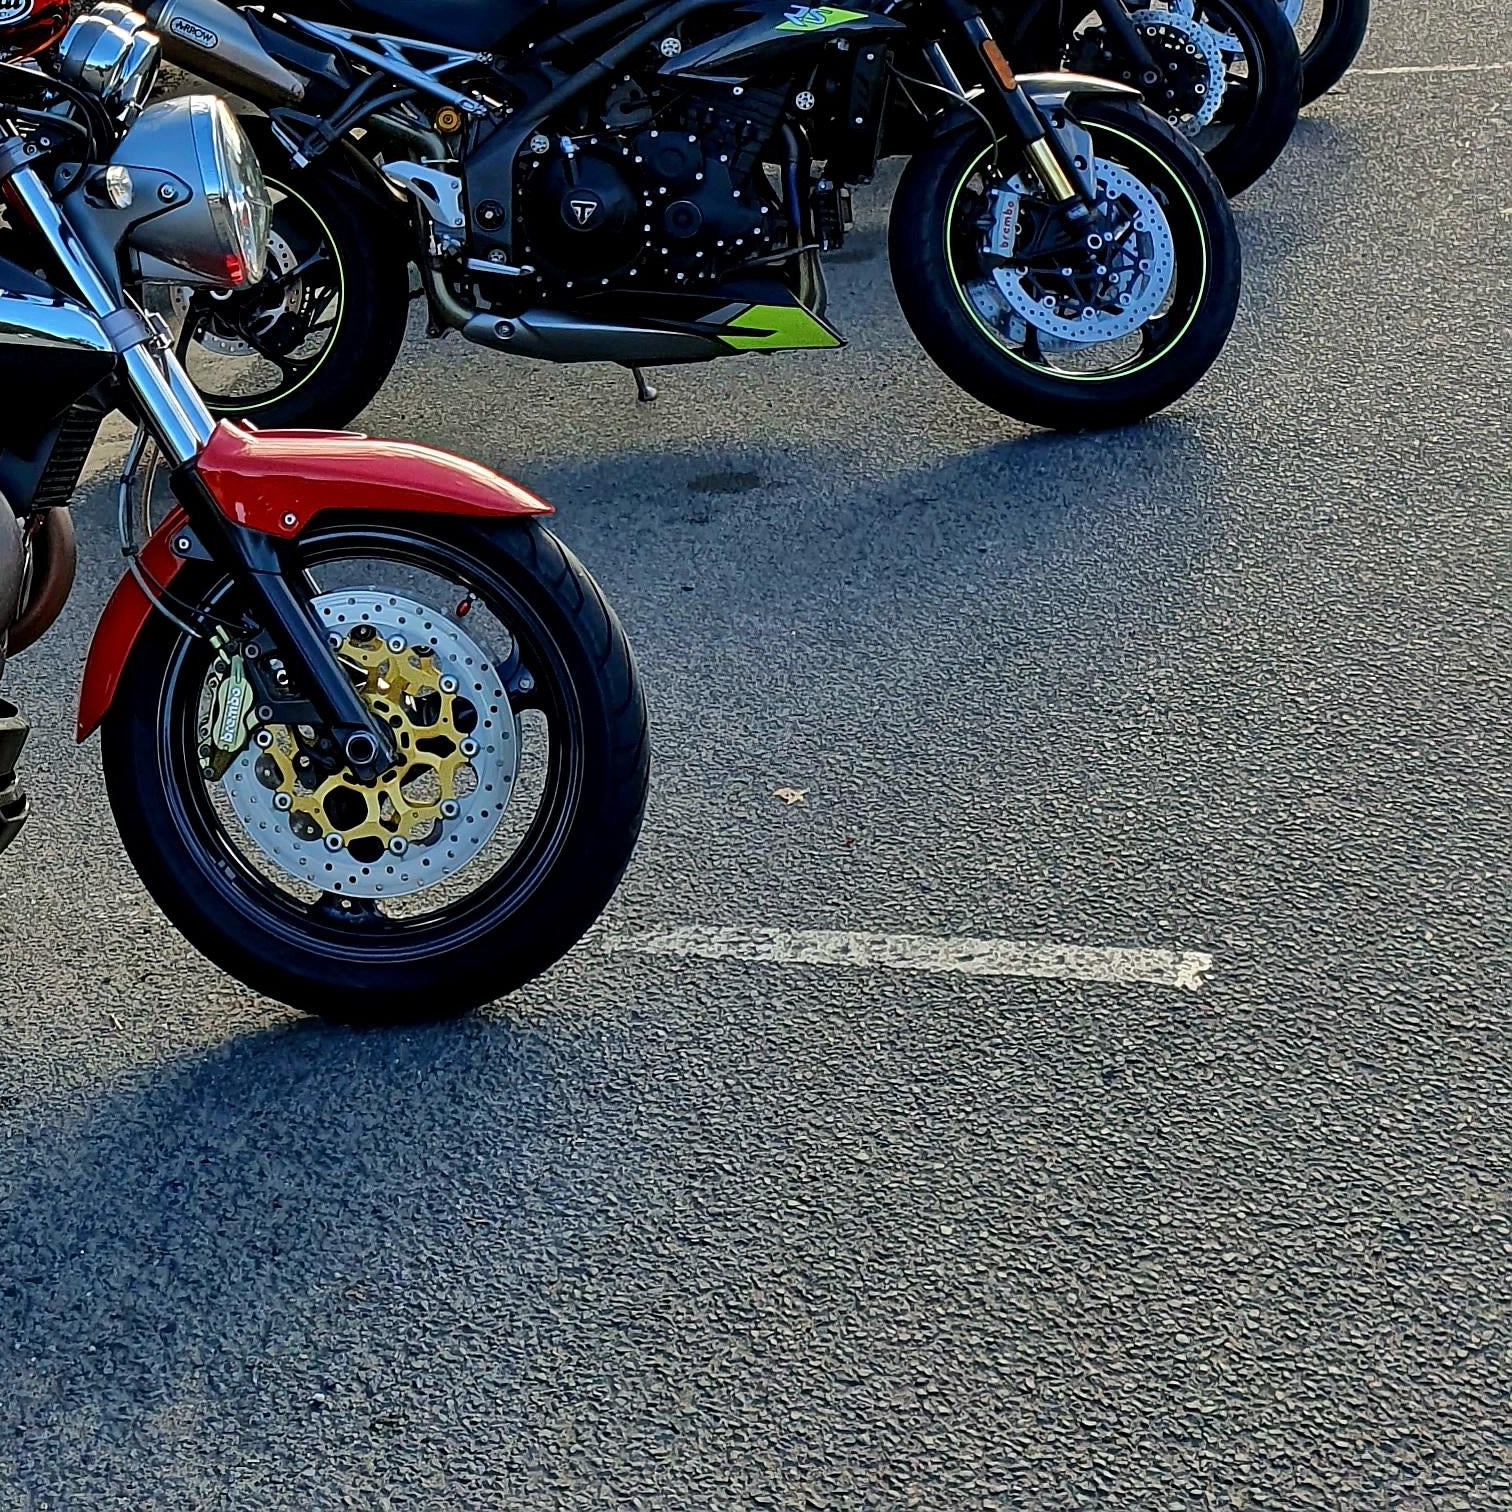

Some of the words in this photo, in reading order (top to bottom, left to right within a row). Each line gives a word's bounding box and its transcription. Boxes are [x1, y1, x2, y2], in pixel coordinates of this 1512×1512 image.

[175, 20, 213, 42] ARROW
[999, 201, 1015, 248] brembo
[220, 687, 241, 743] brembo
